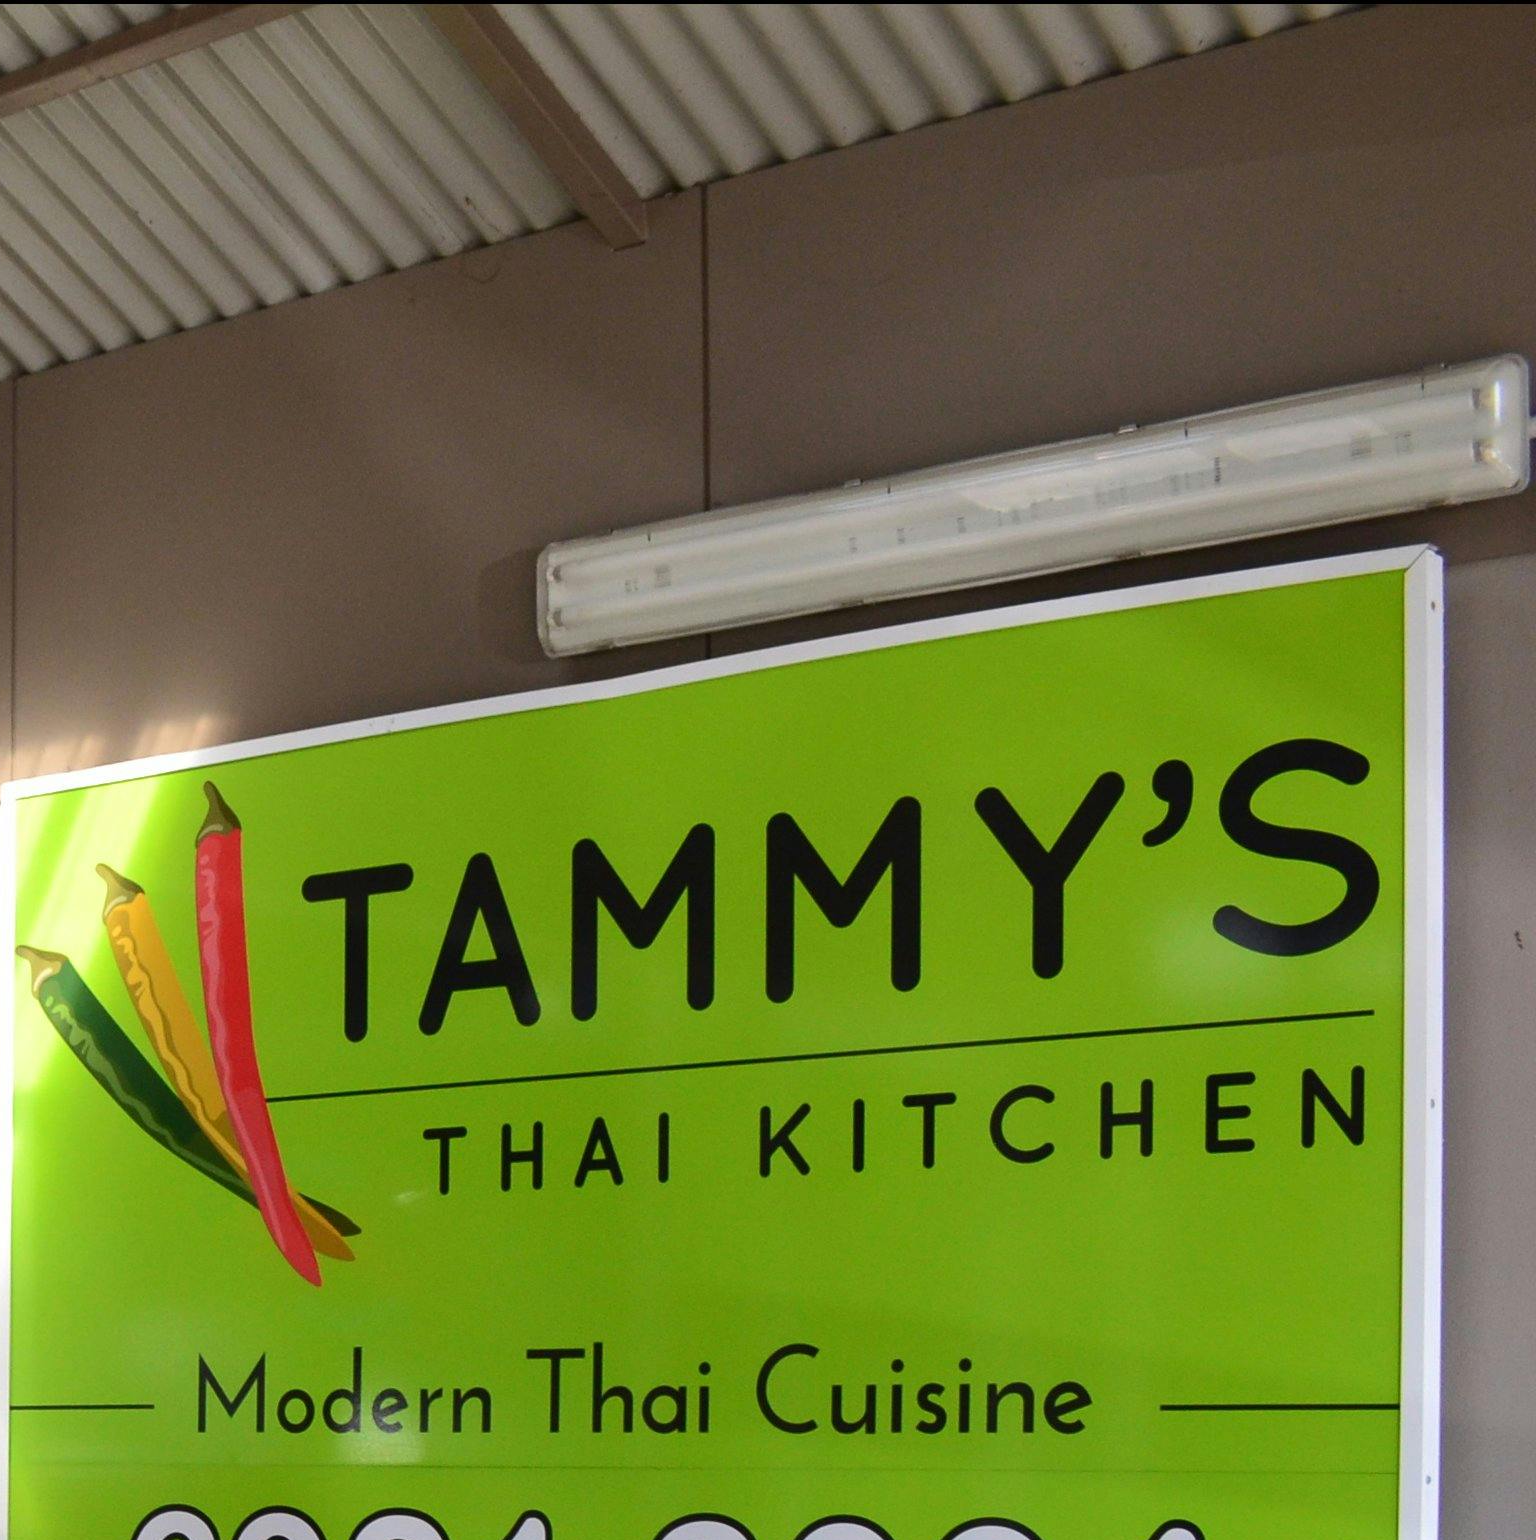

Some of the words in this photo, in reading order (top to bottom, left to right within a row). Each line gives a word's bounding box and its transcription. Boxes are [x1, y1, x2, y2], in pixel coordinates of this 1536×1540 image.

[300, 737, 1381, 1044] TAMMY'S
[422, 1110, 671, 1197] THAI
[759, 1065, 1369, 1179] KITCHEN
[196, 1345, 494, 1436] Modern
[526, 1340, 713, 1436] Thai
[754, 1341, 1095, 1436] Cuisine
